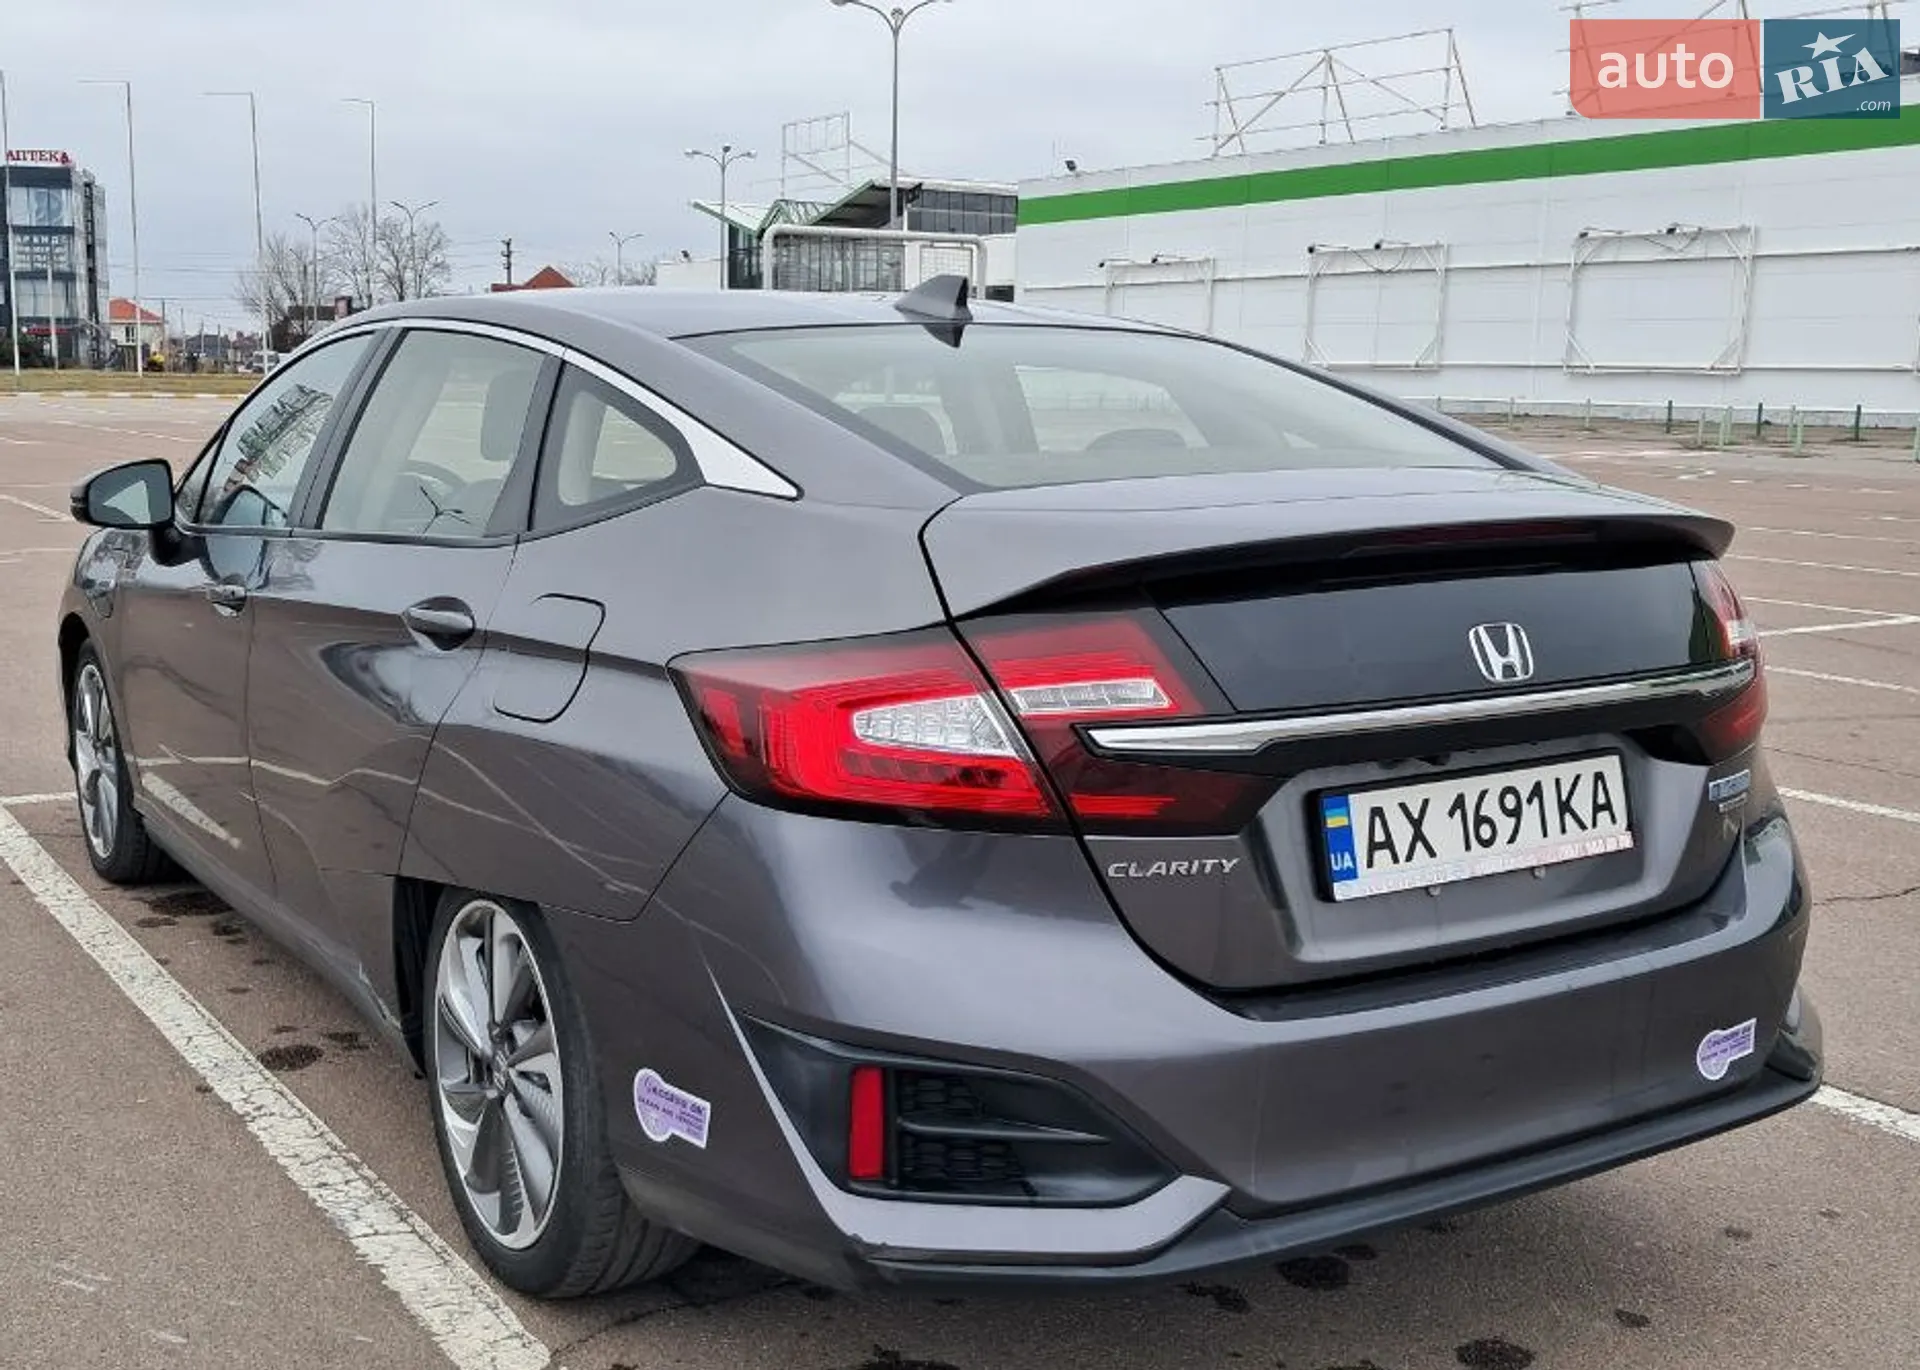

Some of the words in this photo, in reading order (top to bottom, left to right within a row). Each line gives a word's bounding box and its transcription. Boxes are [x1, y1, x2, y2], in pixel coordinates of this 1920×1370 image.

[5, 150, 72, 164] АПТЕКА
[1366, 798, 1437, 869] AX
[1447, 779, 1549, 852] 1691
[1554, 771, 1617, 835] KA
[1107, 858, 1241, 878] CLARITY
[1331, 851, 1354, 871] UA
